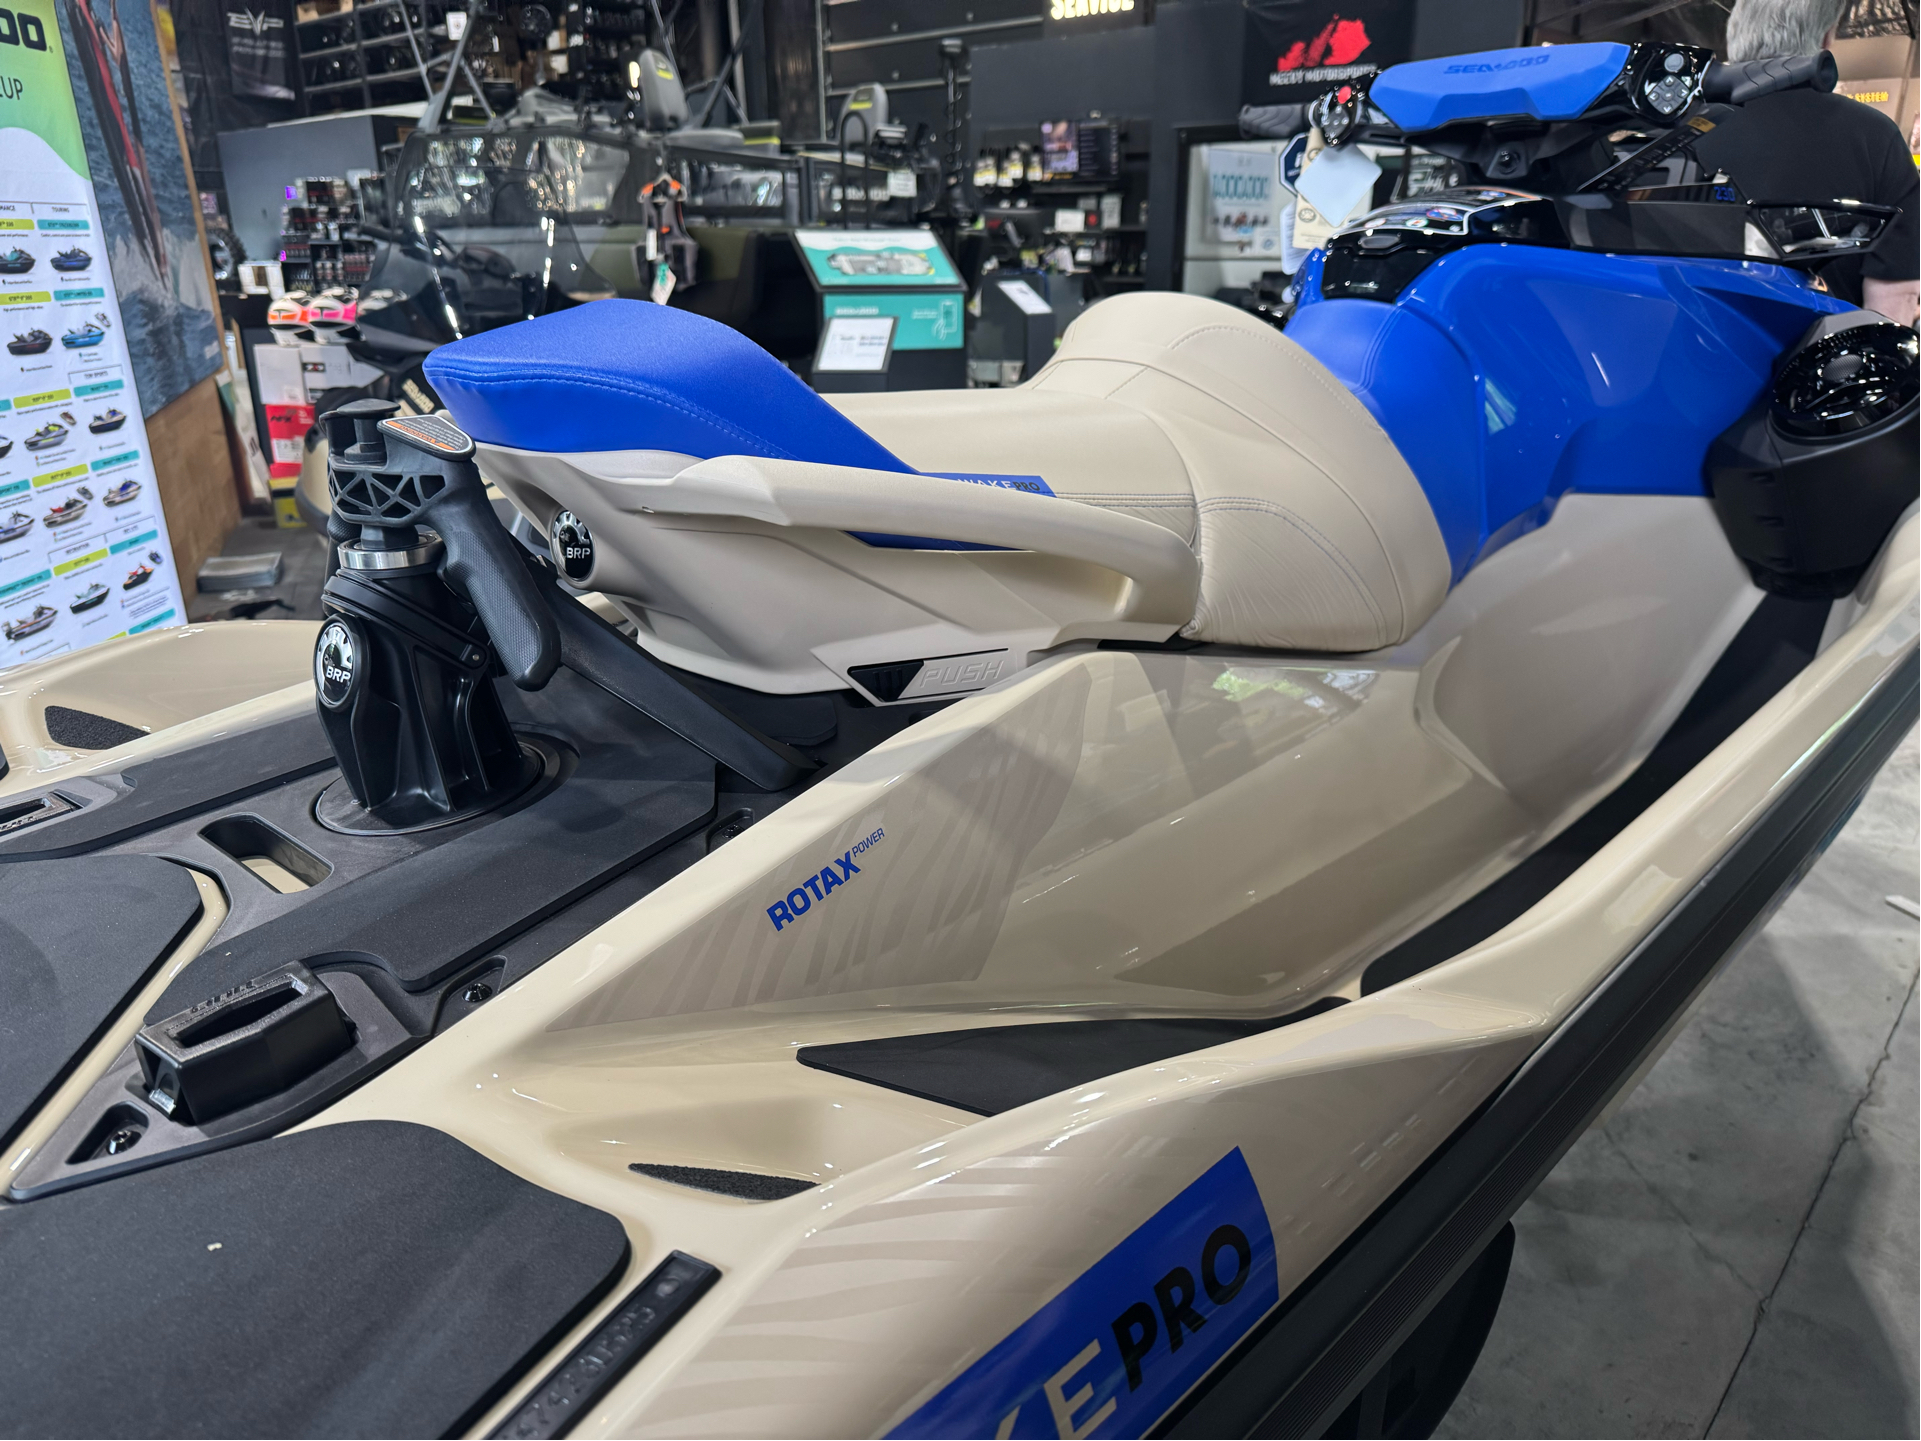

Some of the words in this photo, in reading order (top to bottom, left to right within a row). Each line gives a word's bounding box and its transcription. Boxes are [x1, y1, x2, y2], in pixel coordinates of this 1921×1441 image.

[0, 76, 23, 101] UP
[1713, 186, 1736, 202] 230
[566, 546, 591, 559] BRP
[325, 665, 351, 683] BRP
[919, 659, 1005, 688] PUSH
[766, 850, 861, 932] ROTAX
[851, 827, 885, 858] POWER
